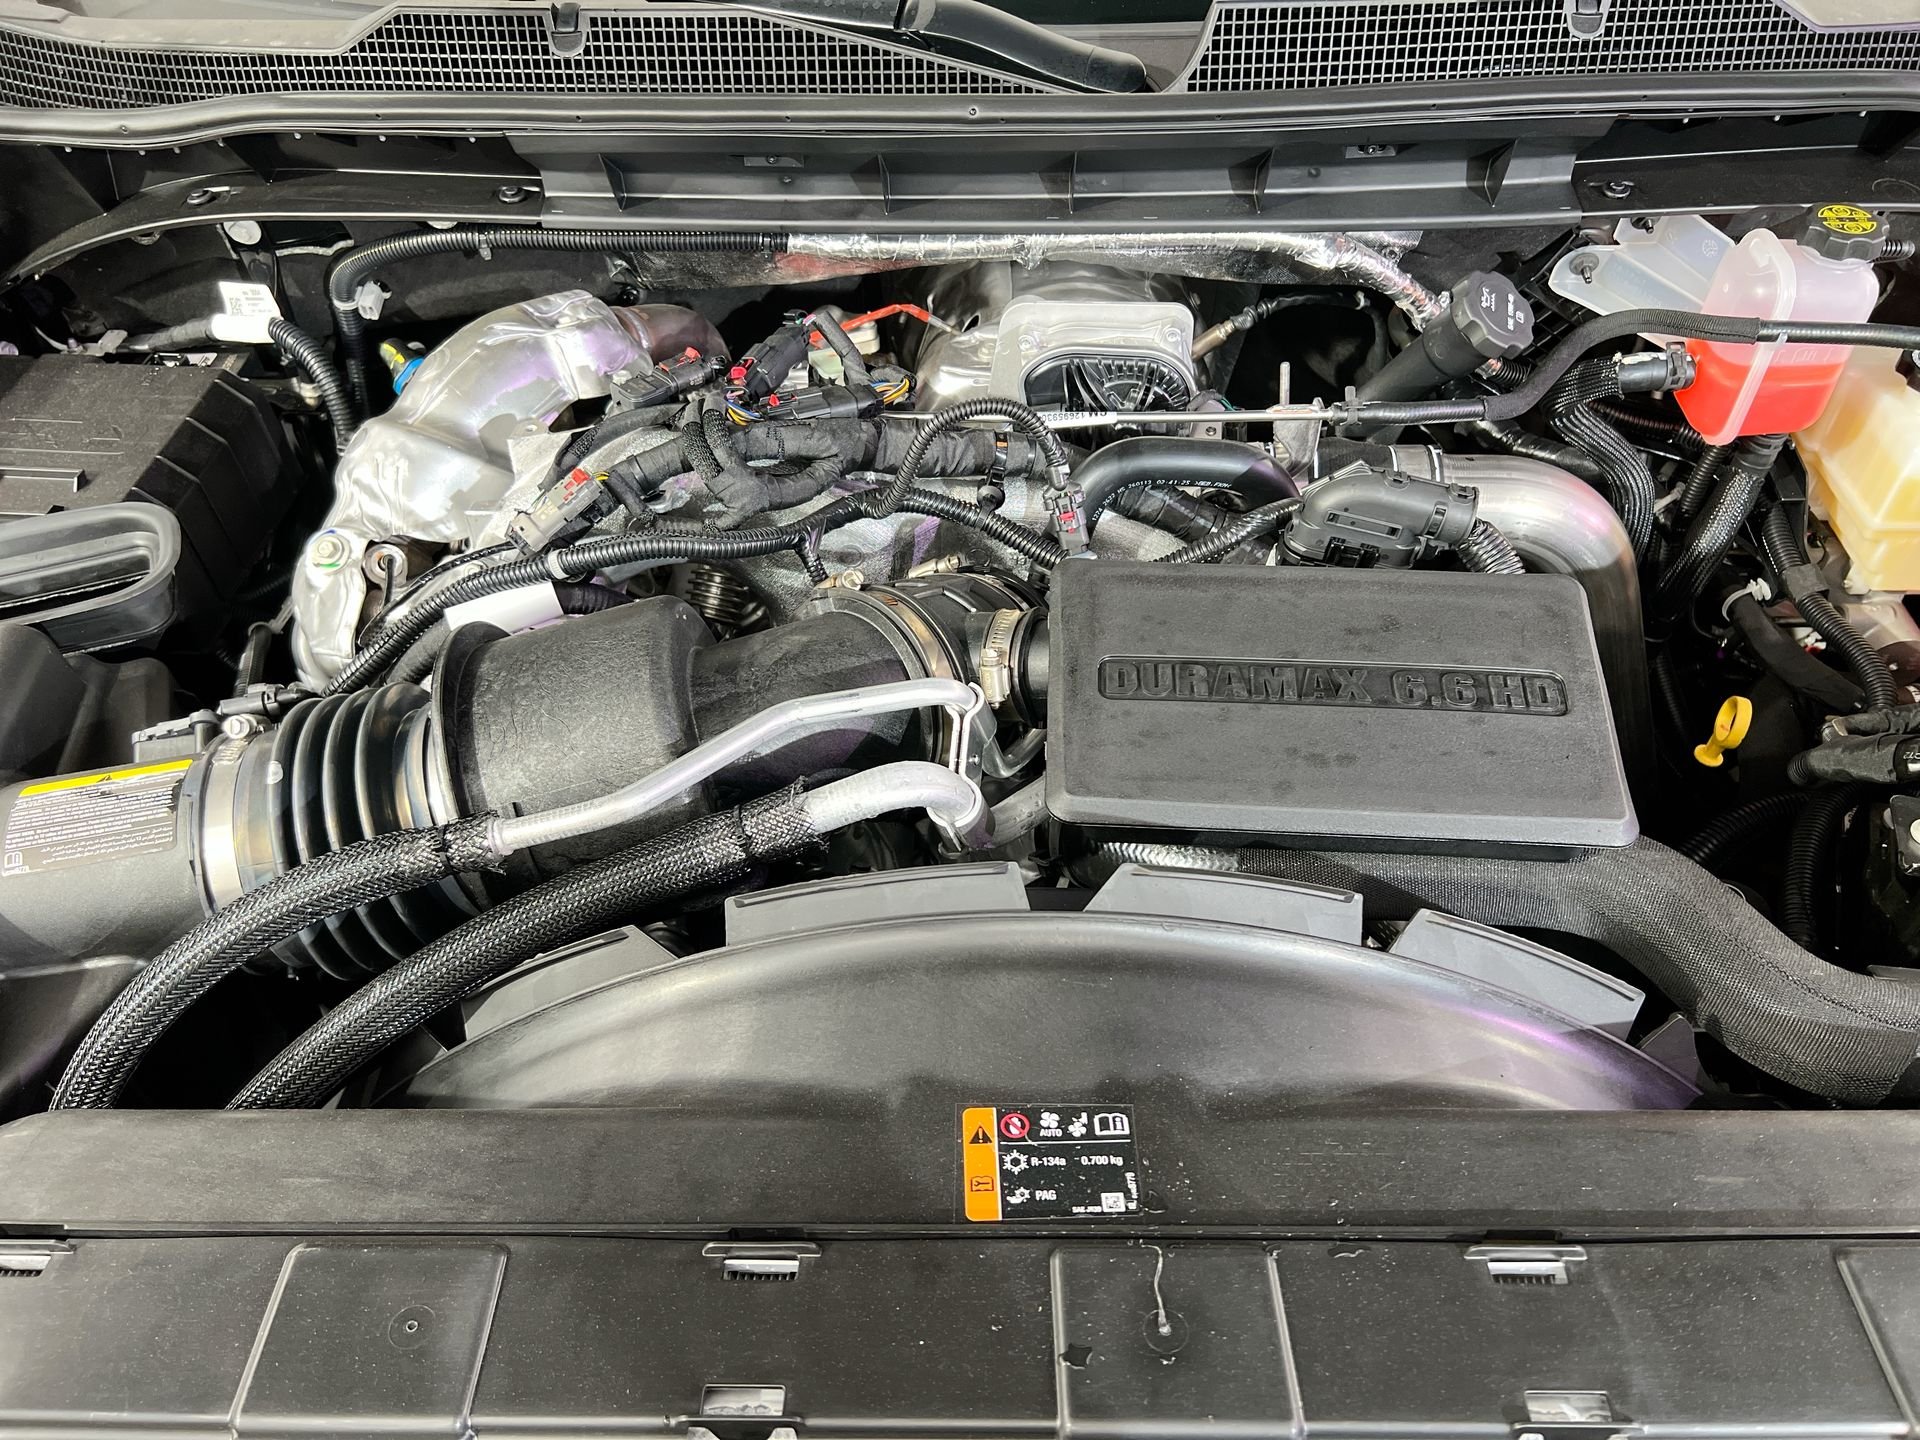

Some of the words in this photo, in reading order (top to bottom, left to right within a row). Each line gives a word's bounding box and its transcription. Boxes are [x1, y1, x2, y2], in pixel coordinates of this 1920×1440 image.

[1104, 661, 1372, 702] DURAMAX
[1390, 670, 1479, 707] 6.6
[1487, 674, 1562, 712] HD
[1039, 1129, 1063, 1137] AUTO
[1030, 1156, 1067, 1166] R-134a
[1080, 1156, 1109, 1165] 0.700
[1110, 1155, 1124, 1167] kg
[1035, 1190, 1057, 1200] PAG
